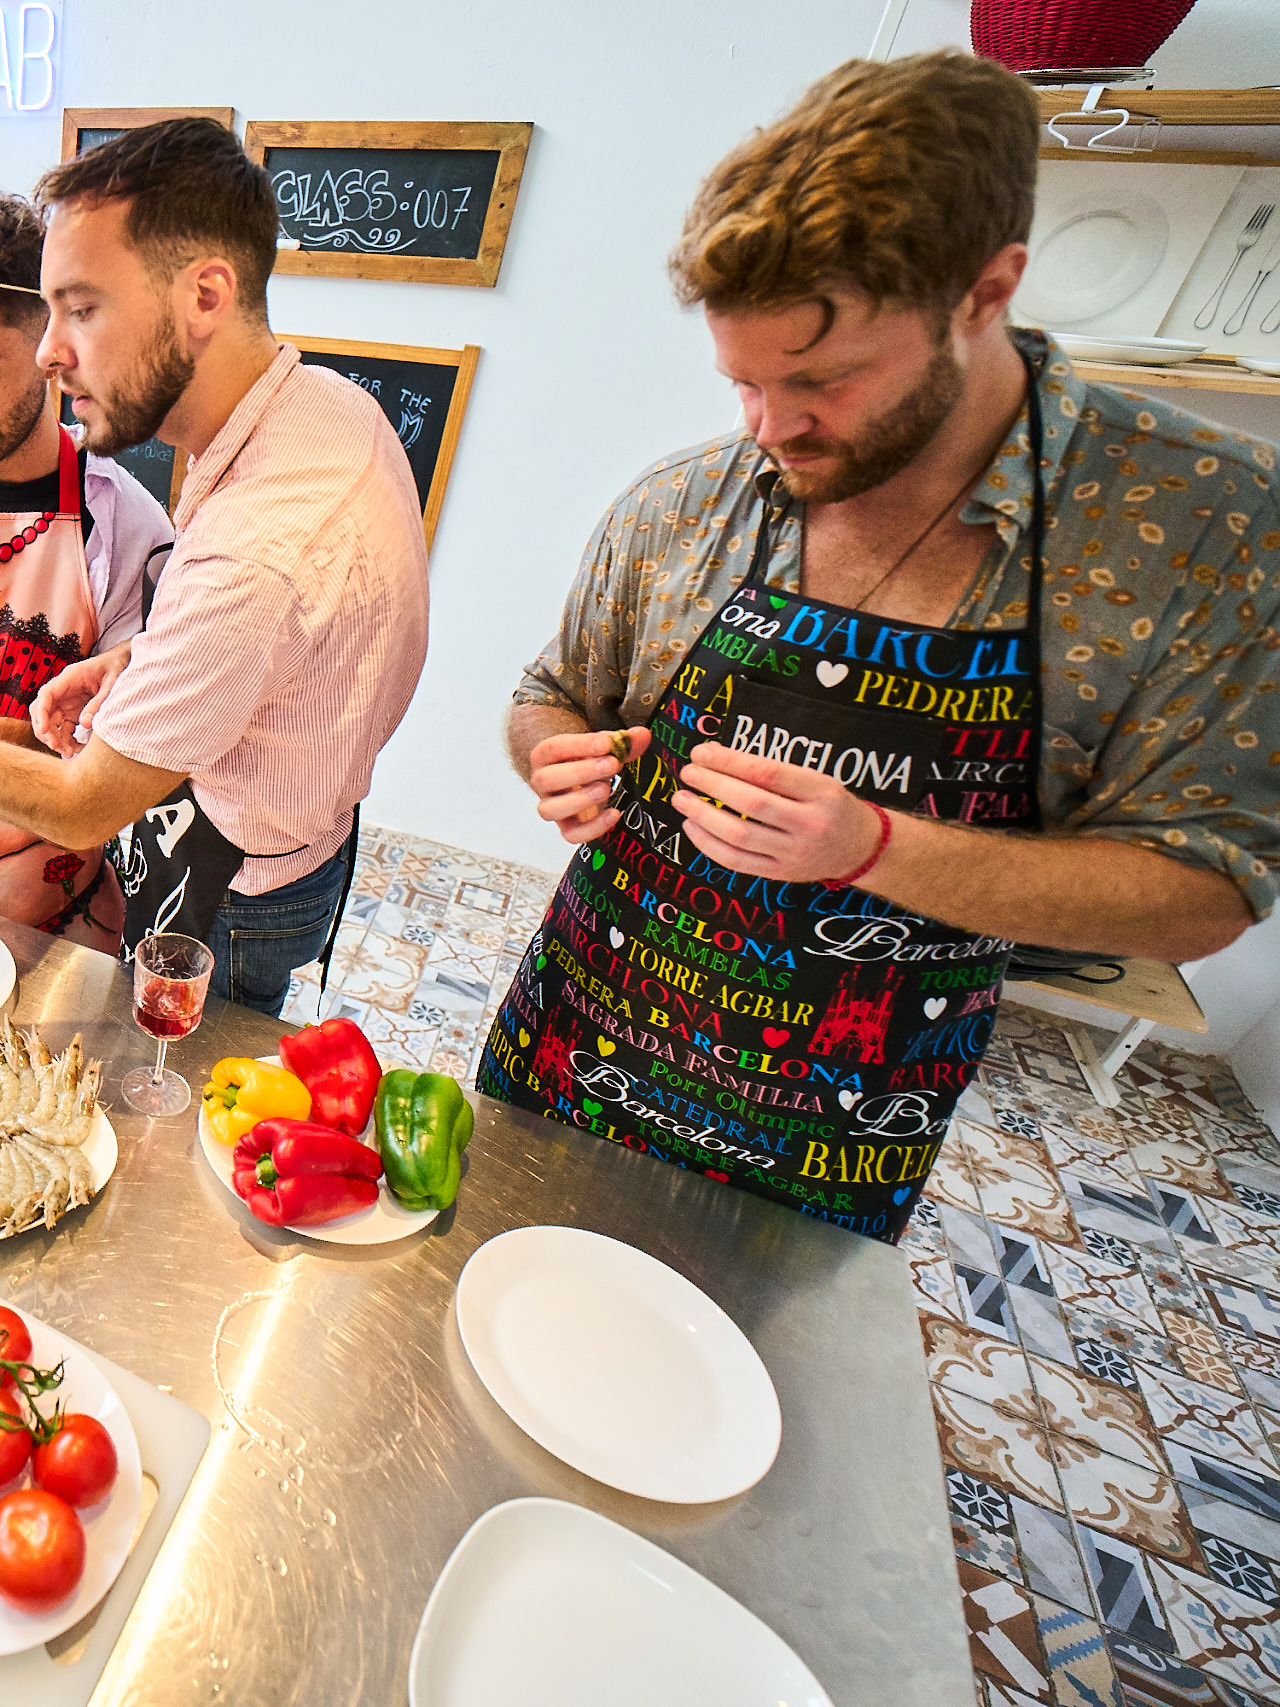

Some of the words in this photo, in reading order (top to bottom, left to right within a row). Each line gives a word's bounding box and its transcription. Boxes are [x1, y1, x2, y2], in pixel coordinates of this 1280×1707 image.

[399, 388, 432, 415] THE
[730, 714, 913, 794] BARCELONA
[573, 869, 623, 925] COLÓN
[642, 918, 794, 991] RAMBLAS
[612, 867, 797, 970] BARCELONA
[545, 937, 634, 1020] PEDRERA
[646, 1006, 864, 1092] BARCELONA
[554, 905, 722, 1039] BARCELONA
[629, 936, 709, 999] TORRE
[709, 984, 815, 1027] AGBAR
[918, 962, 1004, 991] TORRE
[561, 979, 677, 1063] SAGRADA
[681, 1049, 825, 1114] FAMILIA
[649, 1060, 710, 1099] Port
[562, 1050, 777, 1170] Barcelona
[630, 1078, 794, 1156] CATEDRAL
[634, 1117, 737, 1172] TORRE
[744, 1166, 855, 1211] AGBAR
